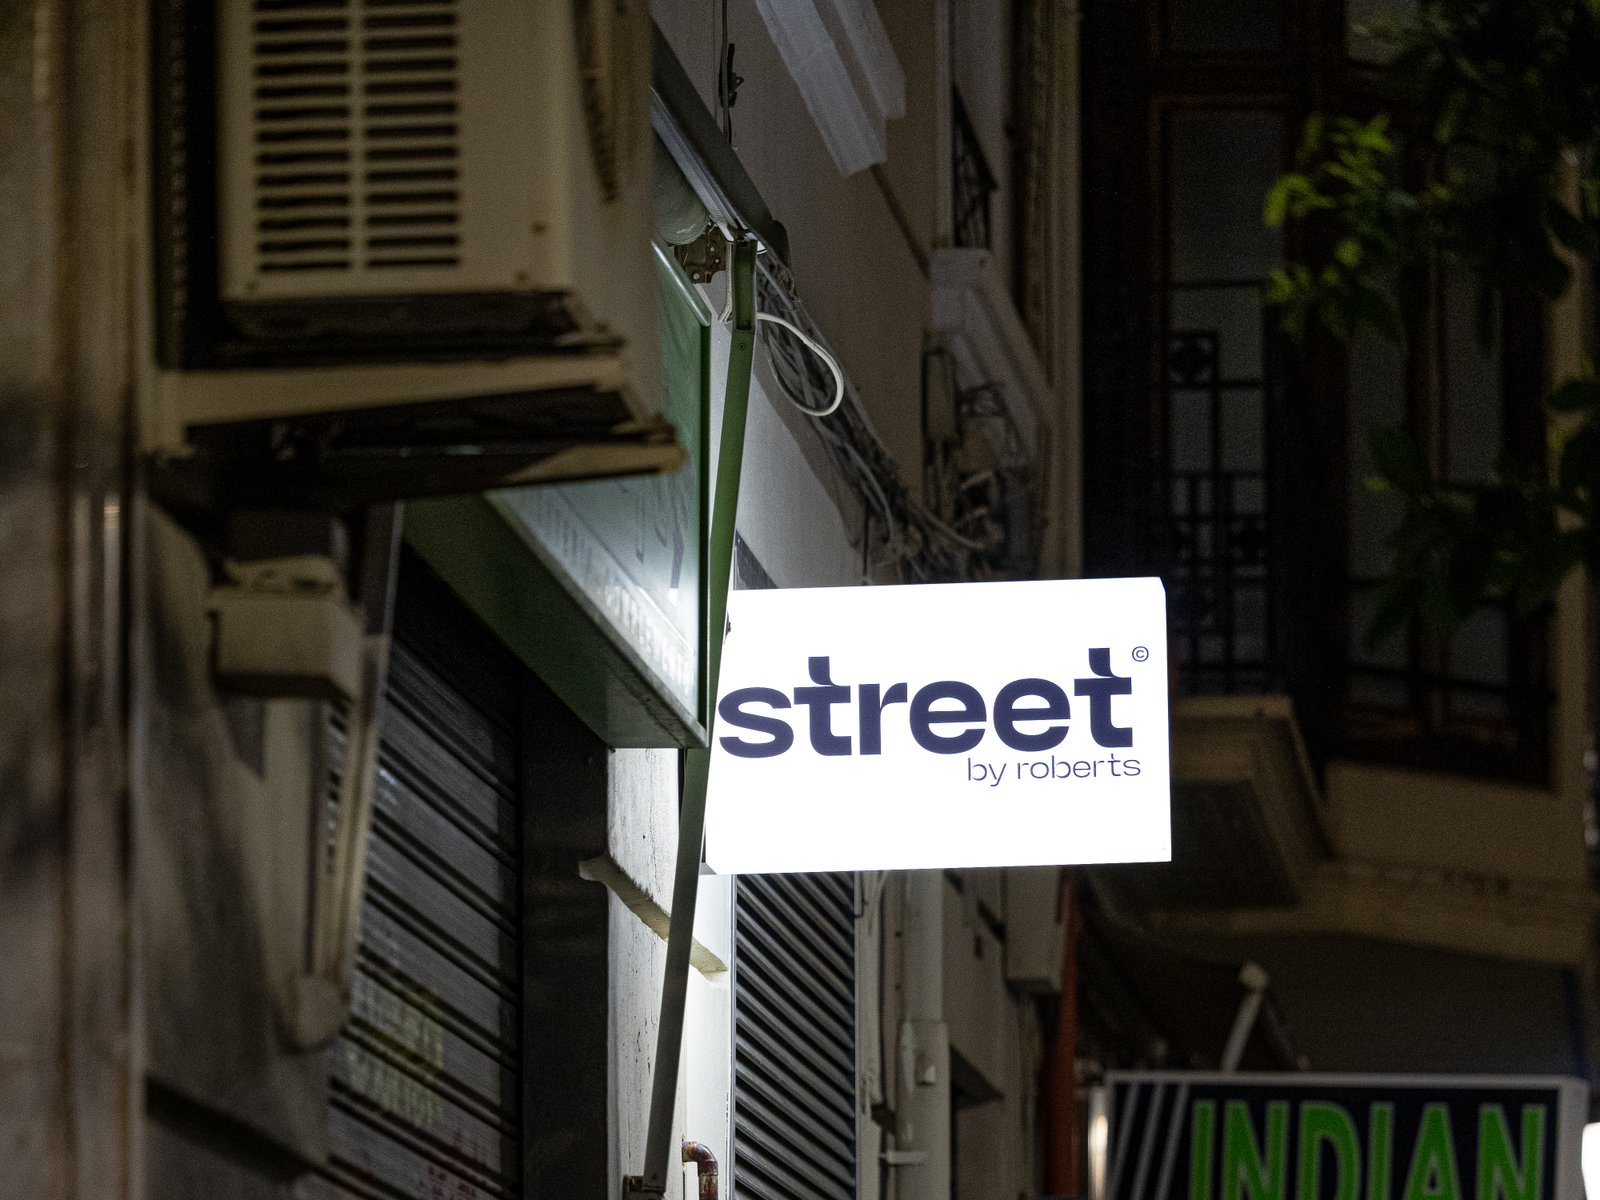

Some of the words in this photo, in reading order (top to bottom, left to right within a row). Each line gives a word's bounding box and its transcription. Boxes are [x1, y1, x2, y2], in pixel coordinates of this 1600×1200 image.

[718, 647, 1132, 758] street
[968, 758, 1007, 786] by
[1017, 753, 1141, 779] roberts
